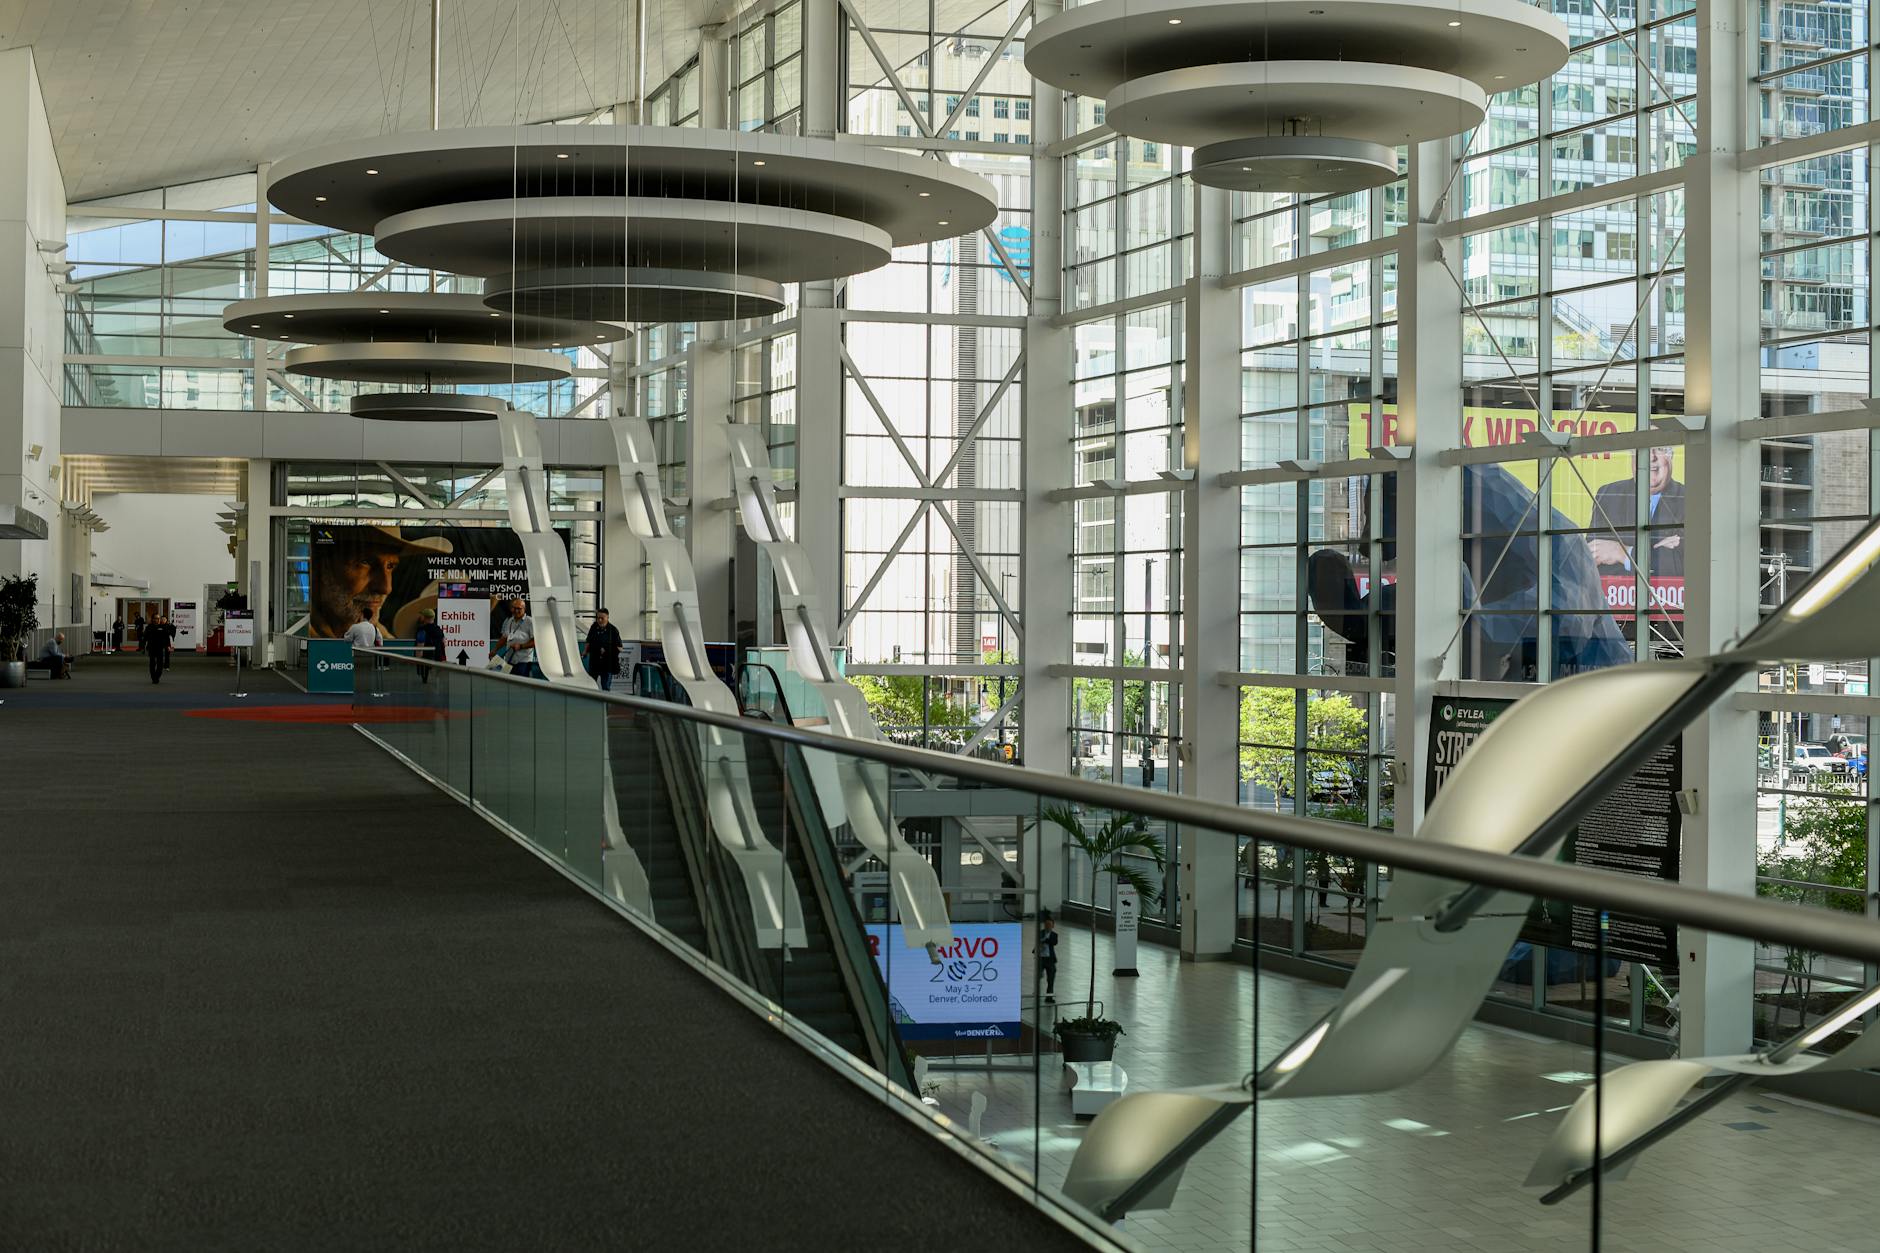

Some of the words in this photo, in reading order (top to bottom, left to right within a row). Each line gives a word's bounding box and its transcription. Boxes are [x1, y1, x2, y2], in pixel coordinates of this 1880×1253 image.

[427, 557, 456, 565] WHEN
[460, 557, 493, 565] YOU'RE
[497, 558, 525, 566] TREAT
[427, 569, 445, 579] THE
[469, 570, 507, 580] MINI-ME
[490, 584, 522, 592] BYSMO
[495, 593, 531, 601] CHOICE
[441, 612, 475, 620] Exhibit
[441, 625, 460, 634] Hall
[445, 639, 484, 647] ntrance
[1457, 709, 1484, 719] EYLEA
[945, 985, 962, 994] May
[929, 995, 960, 1003] Denver,
[961, 994, 998, 1003] Colorado
[966, 1029, 995, 1037] DENVER
